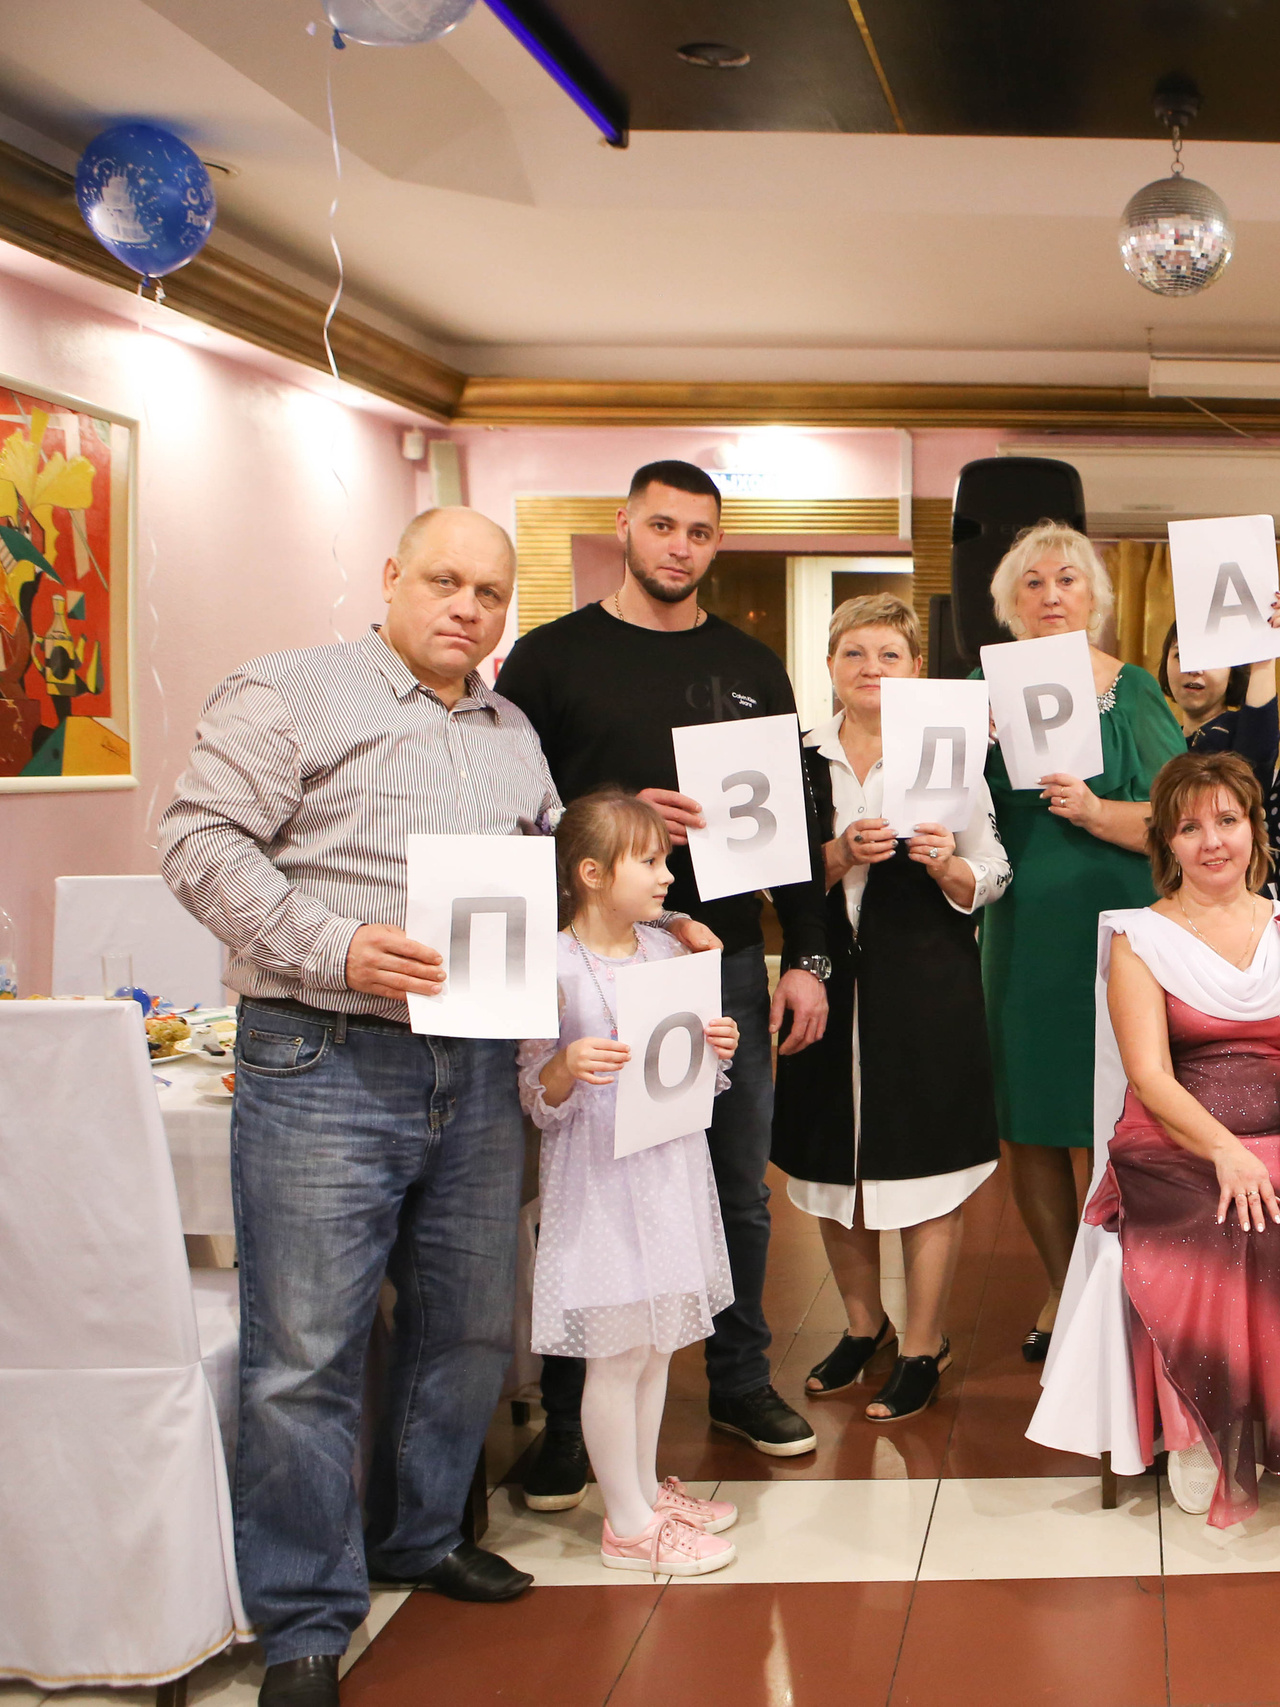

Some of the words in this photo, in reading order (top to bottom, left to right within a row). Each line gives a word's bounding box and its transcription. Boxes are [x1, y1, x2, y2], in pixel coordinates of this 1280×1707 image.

[1204, 561, 1264, 634] А
[1023, 683, 1074, 756] Р
[905, 726, 969, 803] Д
[448, 896, 528, 992] П
[644, 1011, 704, 1104] О
